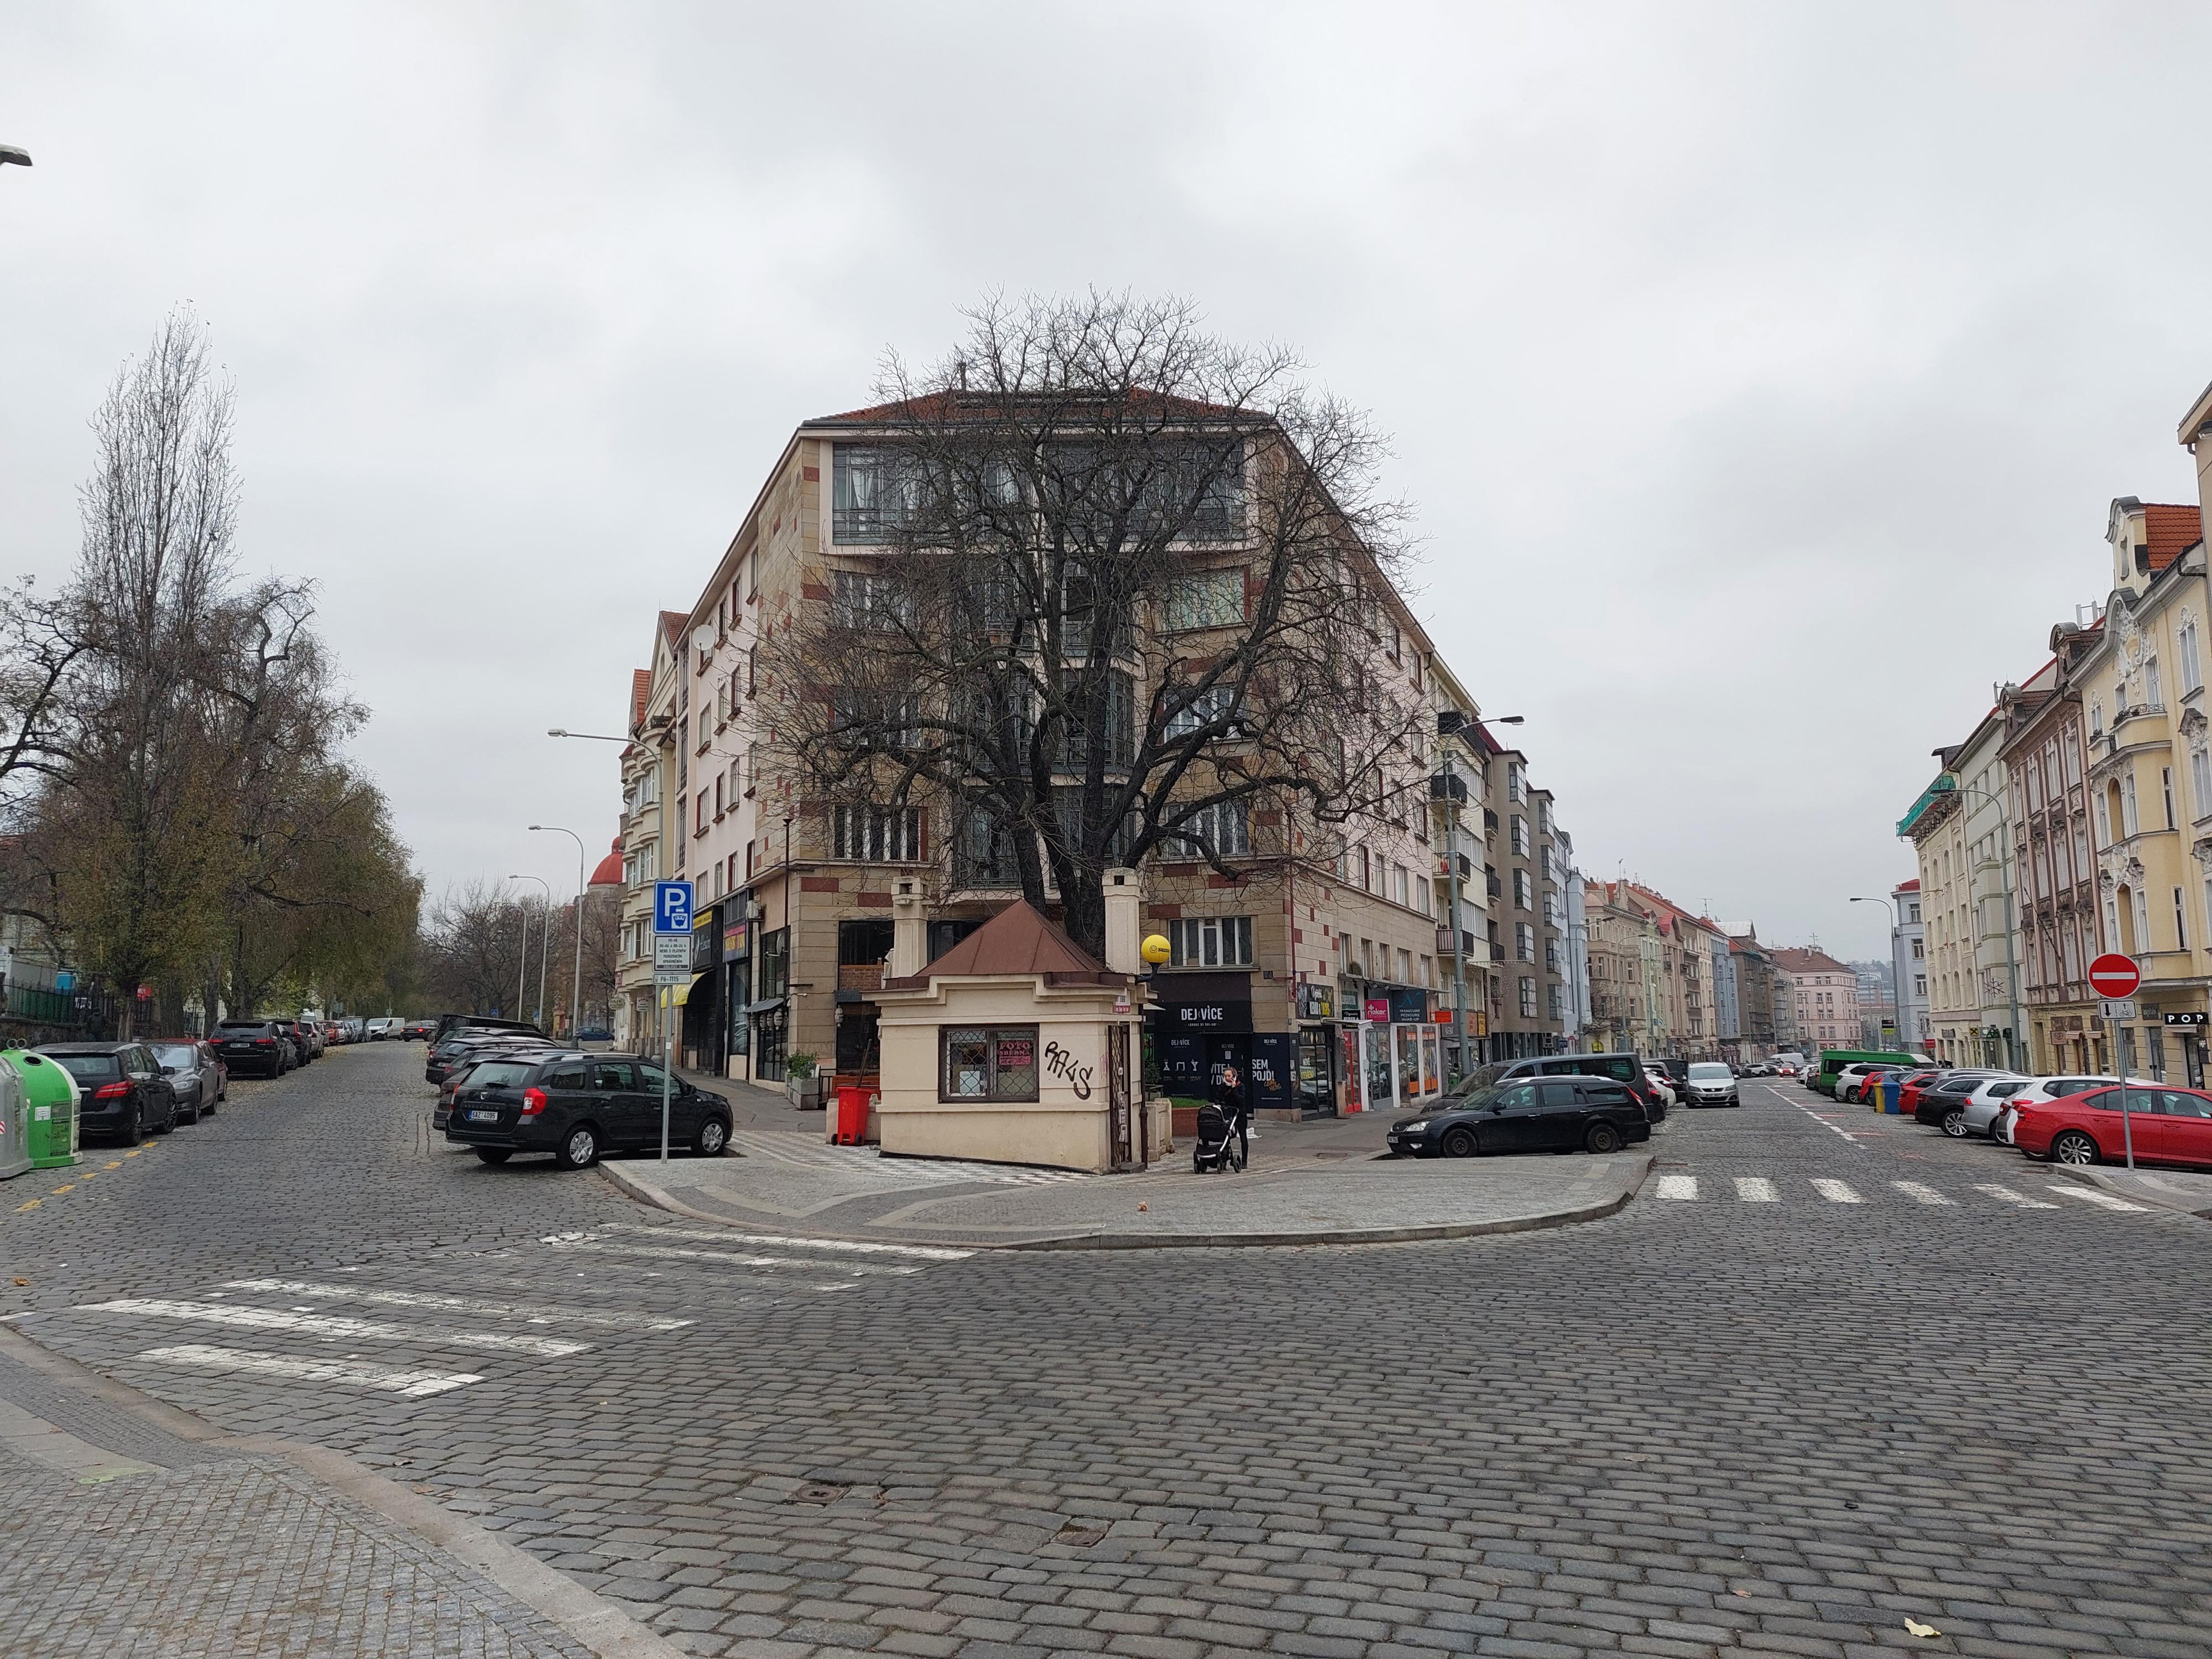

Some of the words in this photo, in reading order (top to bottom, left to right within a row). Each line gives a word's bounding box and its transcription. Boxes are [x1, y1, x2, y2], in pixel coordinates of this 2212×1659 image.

[665, 888, 686, 916] P
[1181, 1008, 1197, 1020] DEJ
[2168, 1014, 2203, 1022] POP
[1252, 1059, 1268, 1070] SEM
